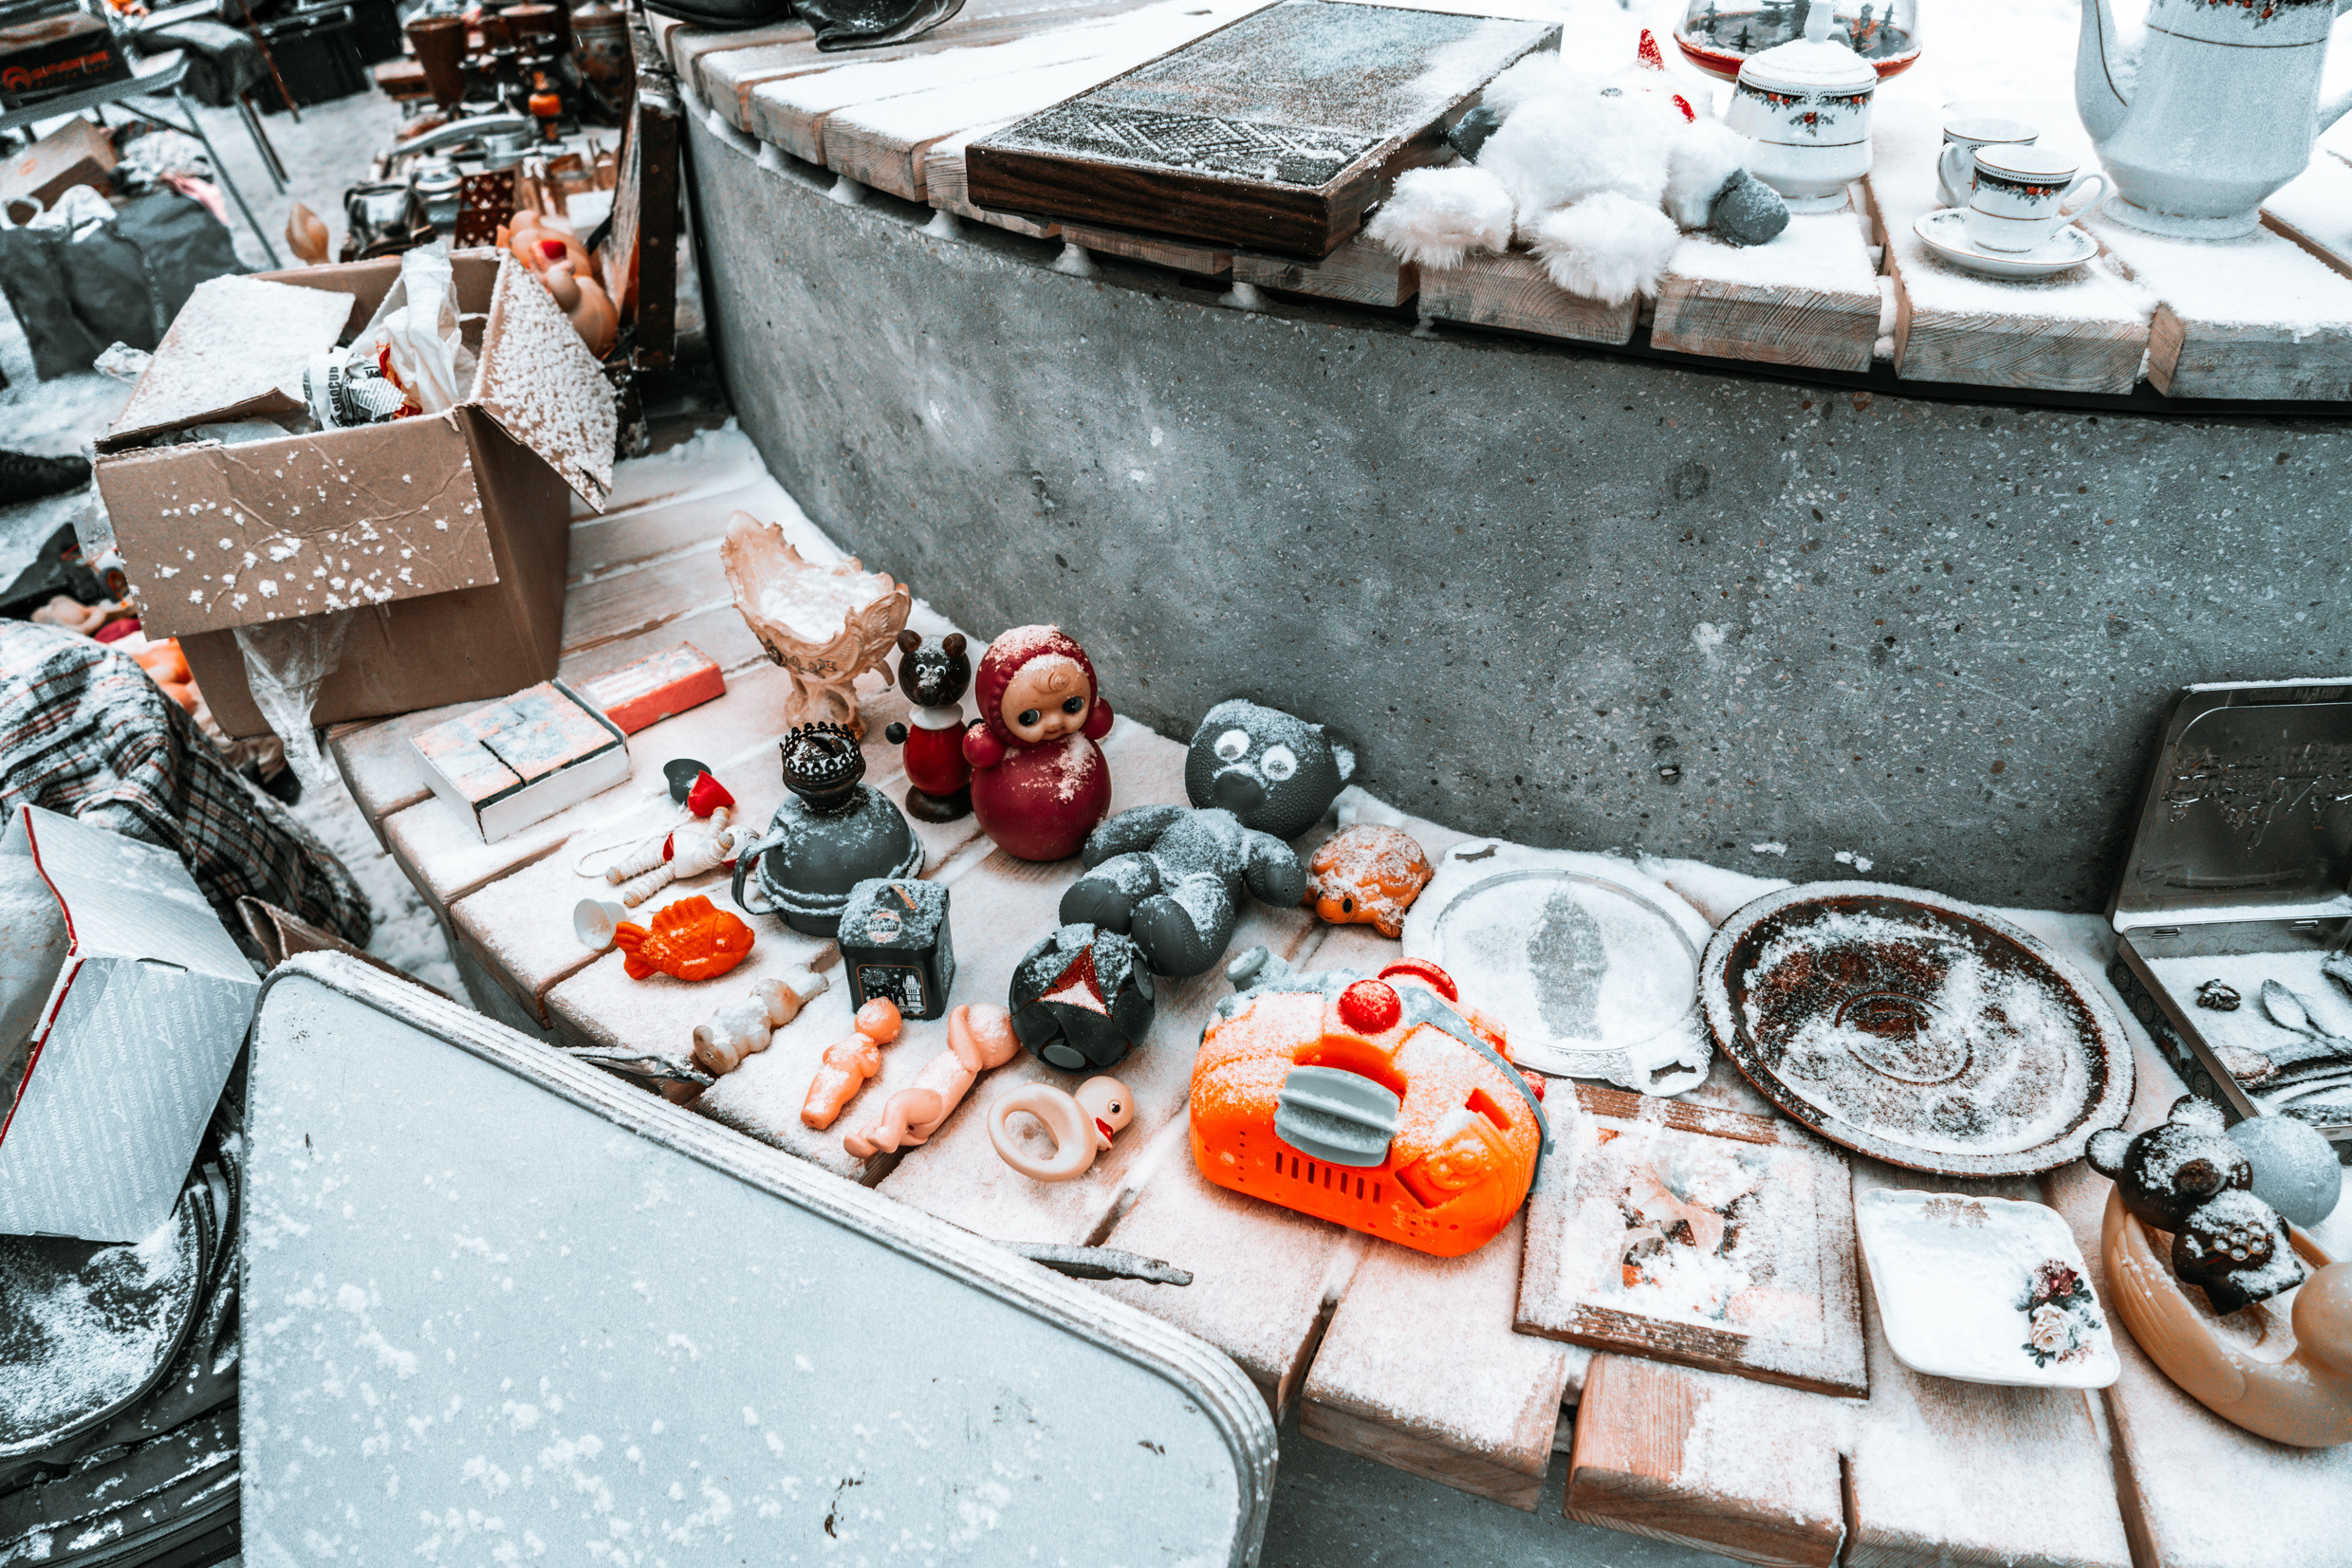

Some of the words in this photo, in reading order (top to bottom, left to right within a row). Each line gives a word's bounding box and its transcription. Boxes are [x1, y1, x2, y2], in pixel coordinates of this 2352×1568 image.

[100, 987, 129, 1063] www.marko.by
[148, 1001, 174, 1052] Marko
[167, 999, 185, 1038] comfort
[210, 986, 230, 1024] Quality,
[93, 1029, 114, 1067] Quality,
[176, 1040, 195, 1086] traditions,
[119, 1070, 138, 1109] comfort
[161, 1057, 189, 1132] www.marko.by
[185, 1086, 203, 1121] Quality,
[44, 1094, 72, 1169] www.marko.by
[62, 1099, 83, 1149] traditions,
[130, 1109, 150, 1157] traditions,
[117, 1131, 143, 1203] www.marko.by
